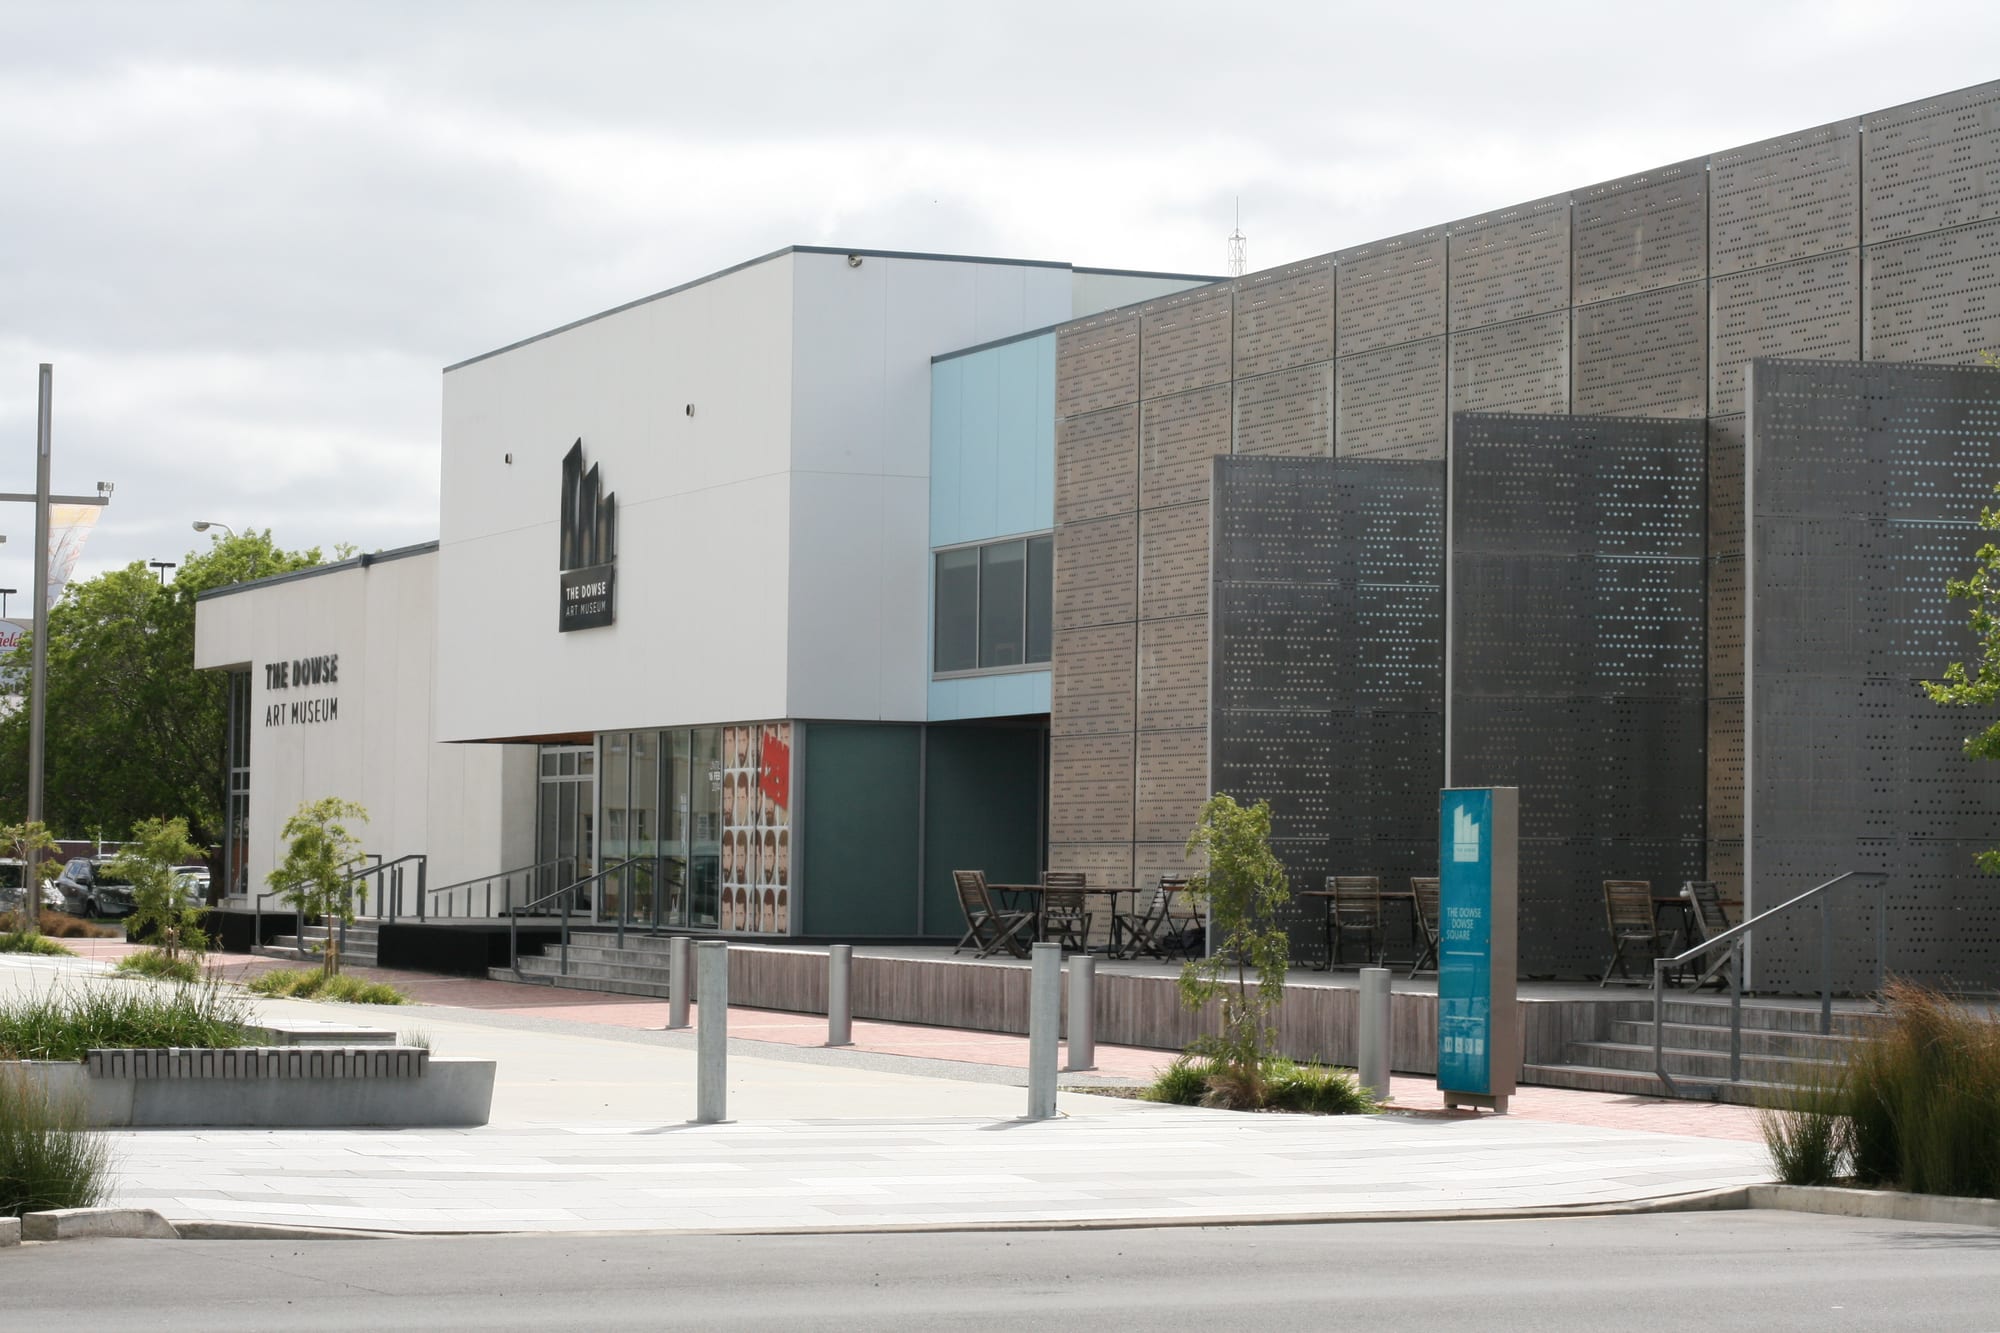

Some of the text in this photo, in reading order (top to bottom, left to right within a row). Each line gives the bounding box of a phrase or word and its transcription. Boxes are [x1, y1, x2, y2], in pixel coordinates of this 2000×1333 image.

[566, 581, 606, 600] THE DOWSE
[565, 600, 606, 616] ART MUSEUM
[265, 653, 338, 690] THE DOWSE
[265, 697, 338, 727] ART MUSEUM
[1446, 907, 1481, 918] THE DOWSE
[1446, 929, 1471, 940] SQUARE
